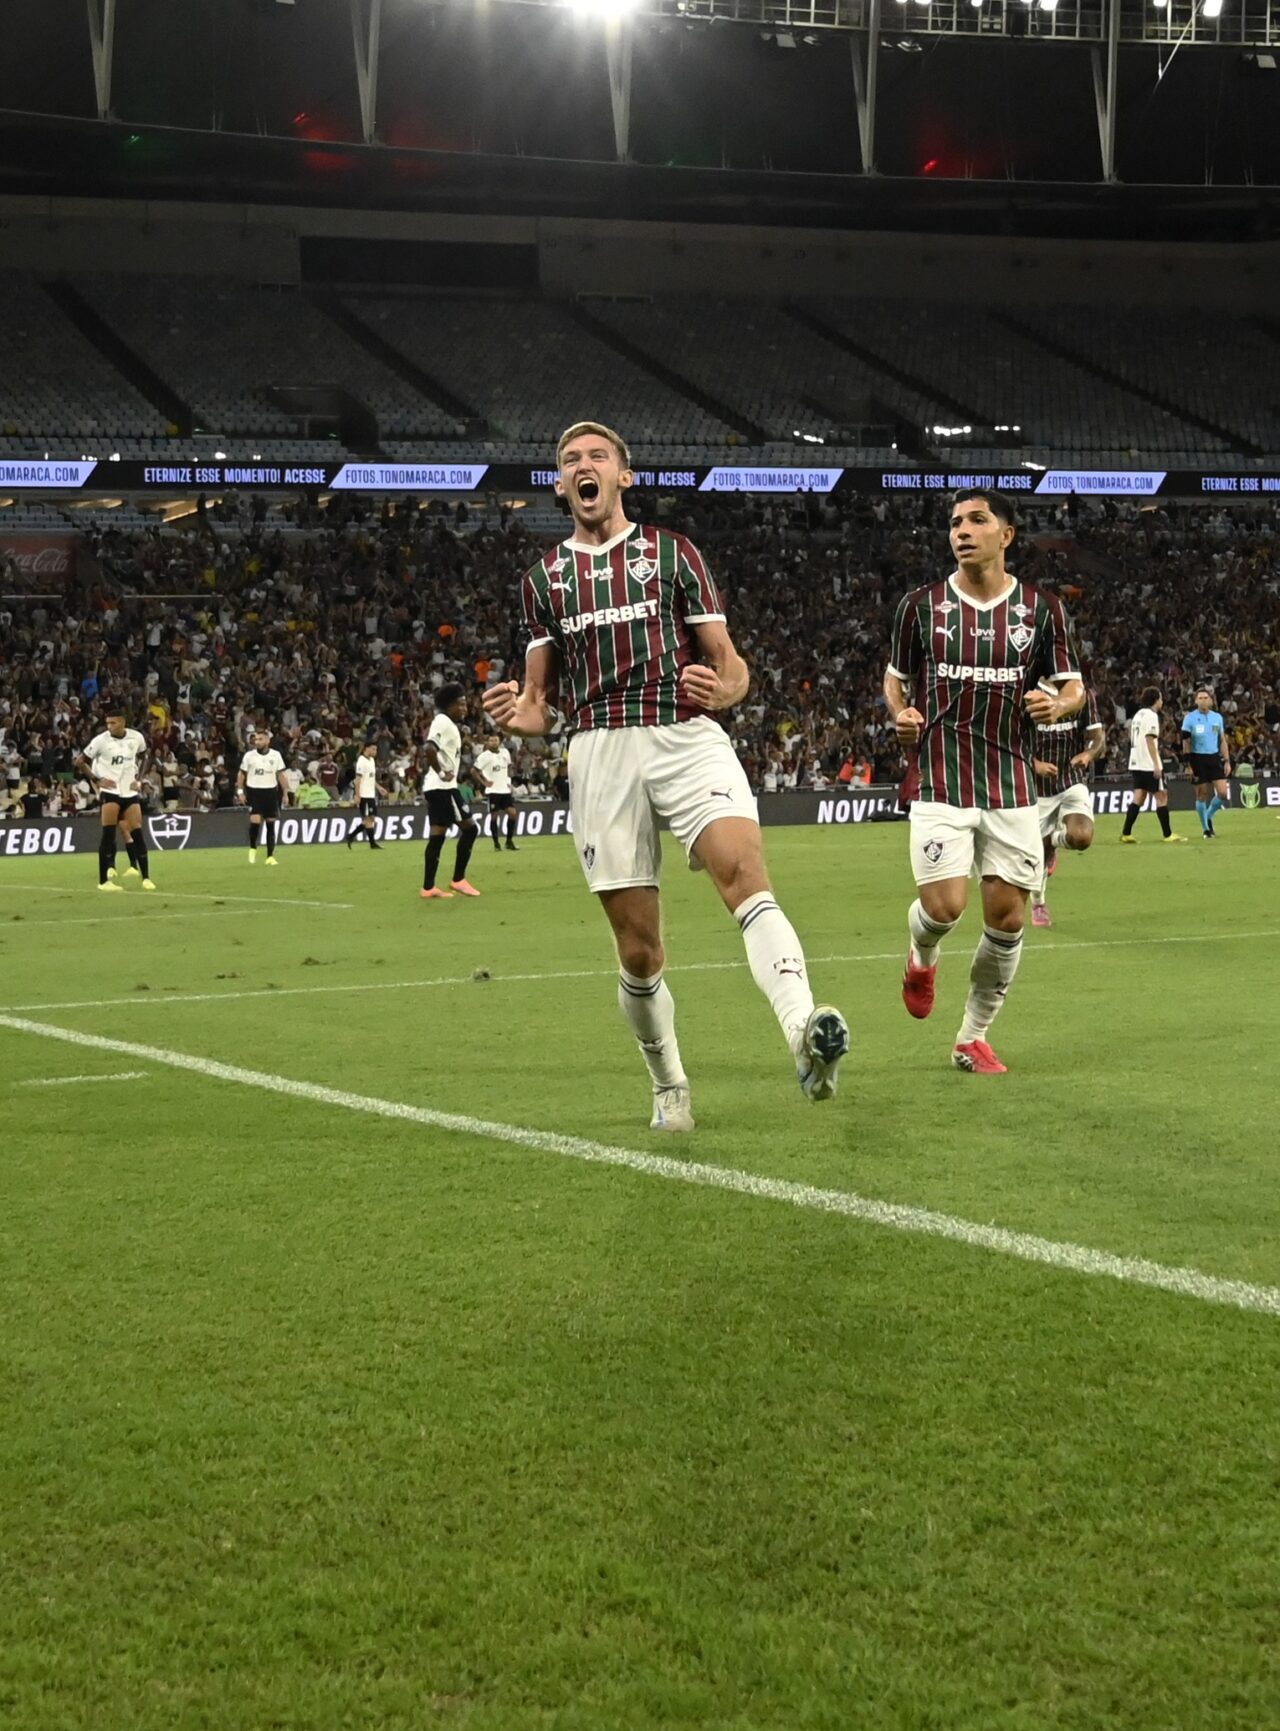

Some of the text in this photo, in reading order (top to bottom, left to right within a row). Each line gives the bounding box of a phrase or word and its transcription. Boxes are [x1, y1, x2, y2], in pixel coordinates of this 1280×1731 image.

[144, 468, 326, 483] ETERNIZE ESSE MOMENTO! ACESSE
[346, 470, 472, 485] FOTOS.TONOMARACA.COM
[658, 472, 696, 486] ACESSE
[713, 473, 828, 487] FOTOS.TONOMARACA.COM
[882, 474, 1031, 489] ETERNIZE ESSE MOMENTO! ACESSE
[1048, 476, 1153, 489] FOTOS.TONOMARACA.COM
[1201, 478, 1237, 491] ETERNIZE
[1240, 478, 1259, 491] ESSE
[560, 599, 657, 634] SUPERBET
[937, 662, 1025, 682] SUPERBET
